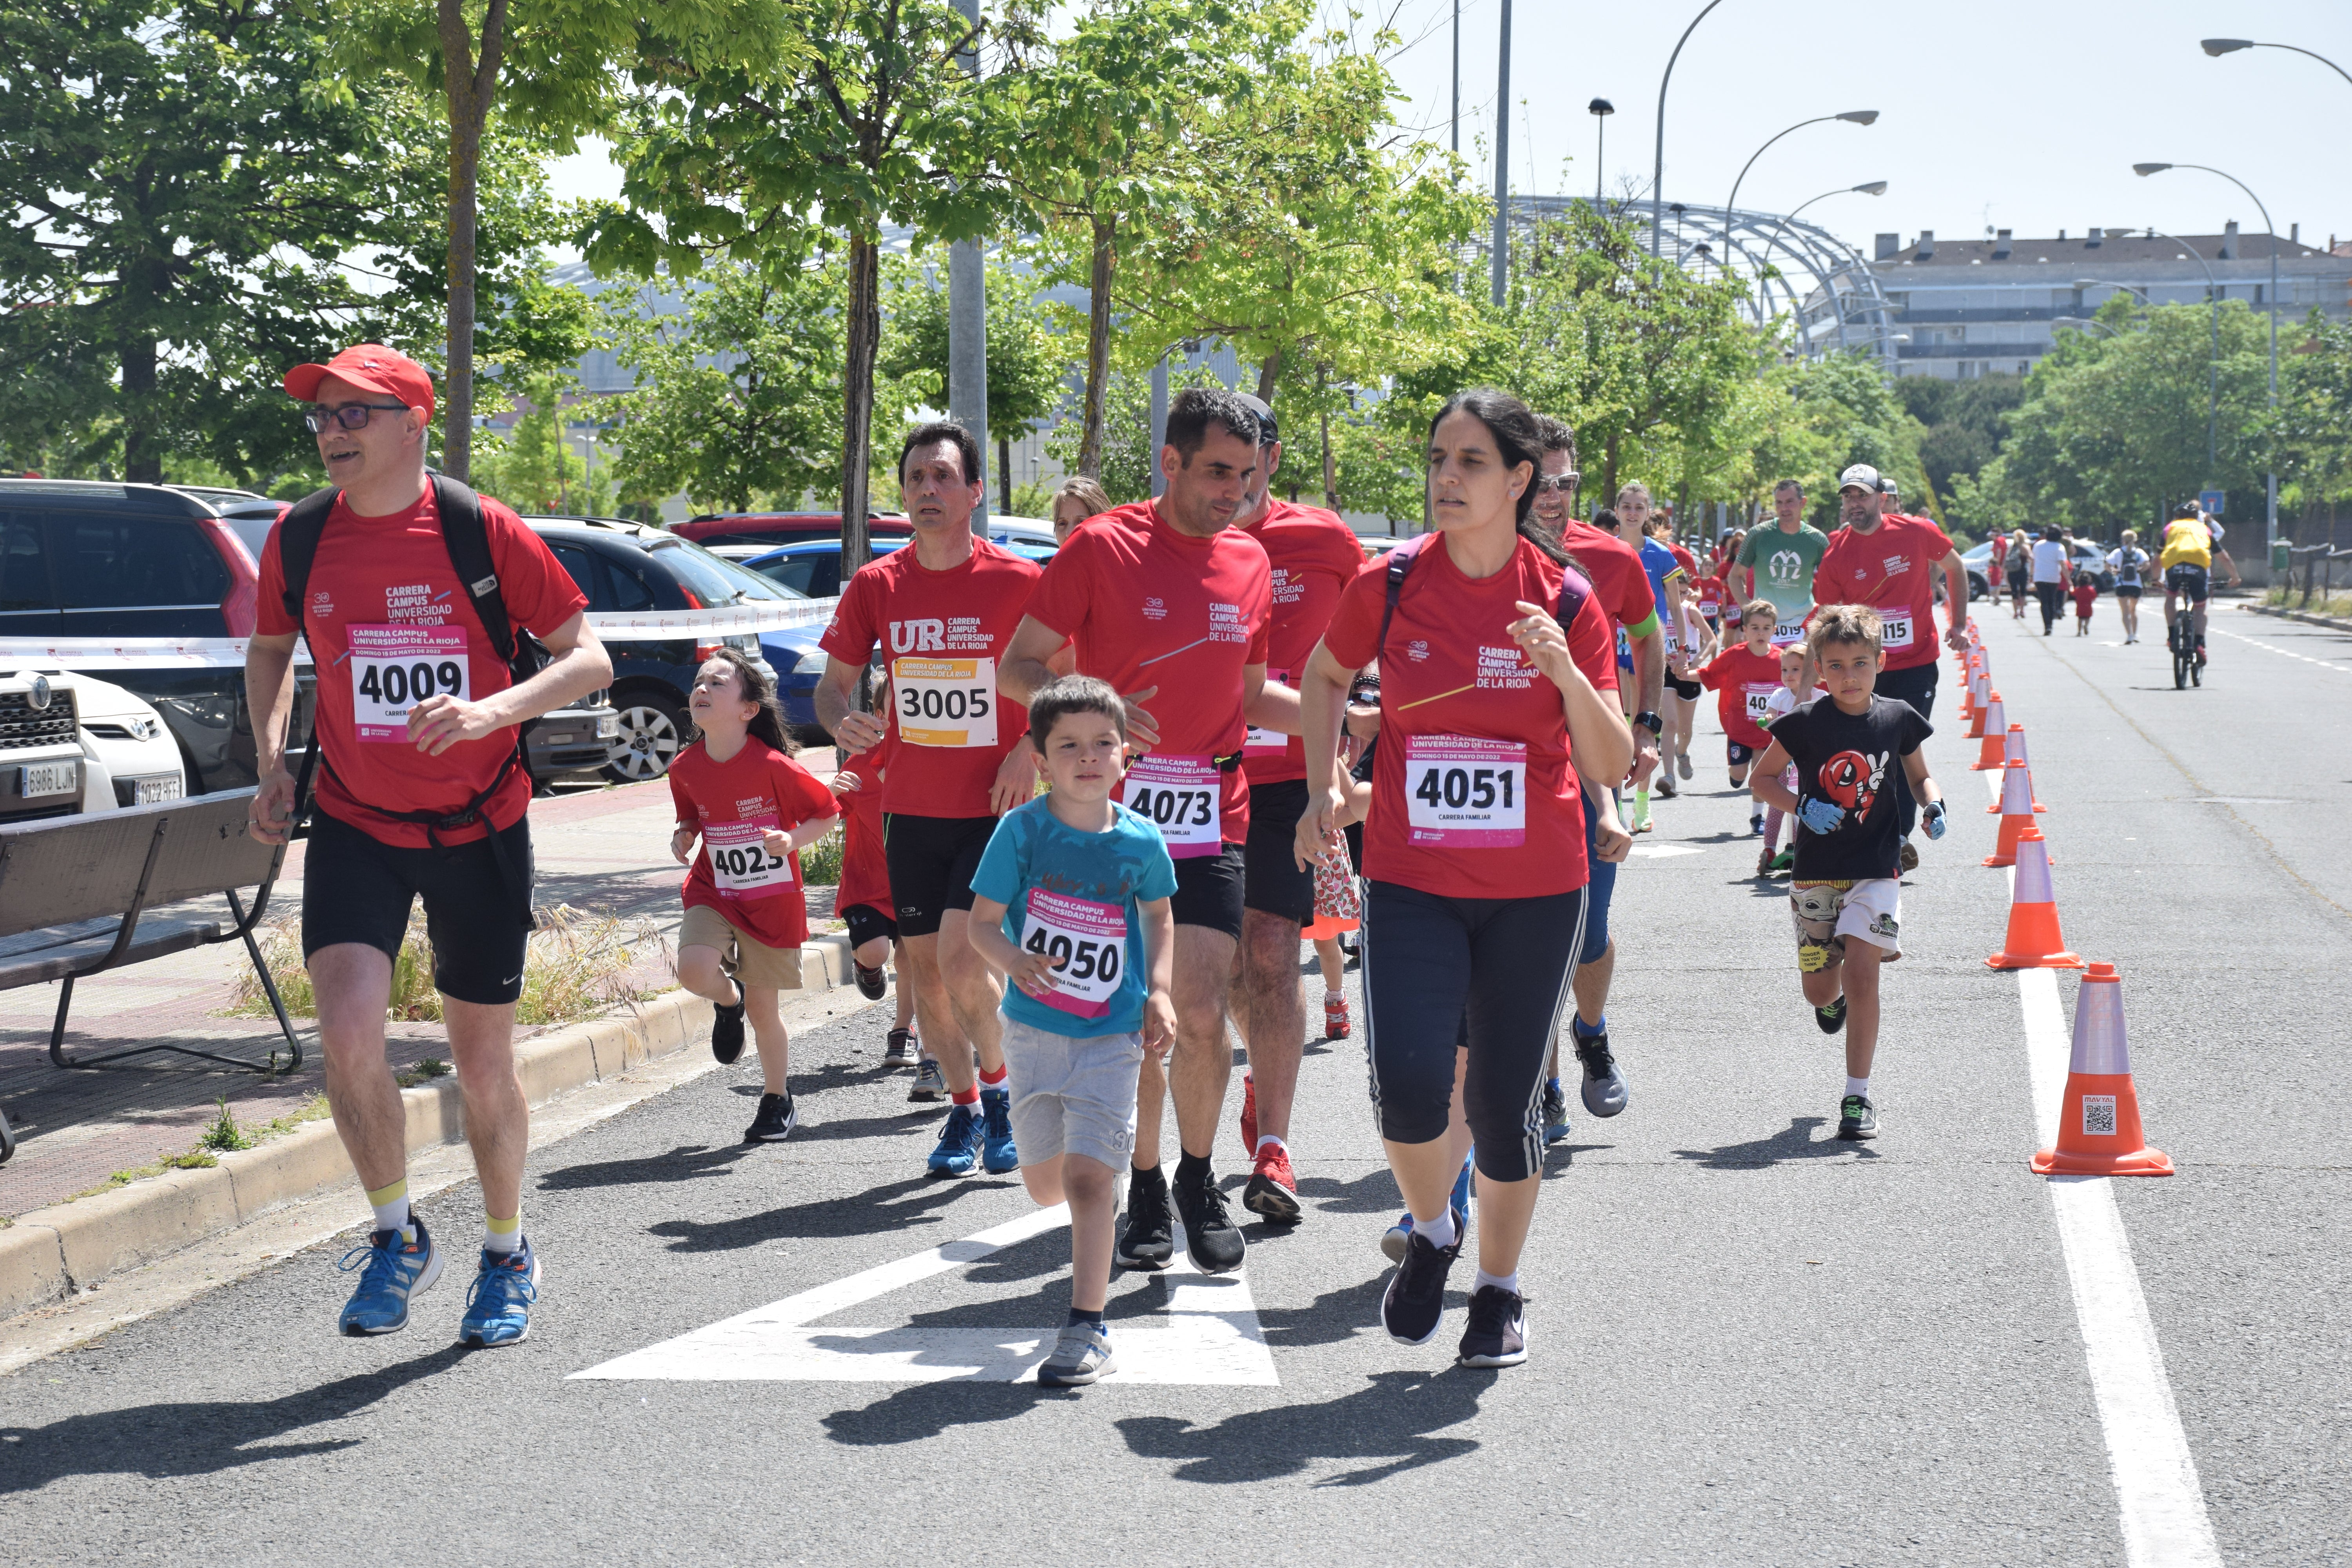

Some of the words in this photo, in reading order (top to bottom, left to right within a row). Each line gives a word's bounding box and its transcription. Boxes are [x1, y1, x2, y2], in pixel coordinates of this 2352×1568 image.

[1883, 555, 1901, 564] CARRERA
[1885, 560, 1901, 568] CAMPUS
[386, 584, 431, 597] CARRERA
[314, 592, 329, 603] 30
[387, 595, 428, 608] CAMPUS
[1146, 597, 1163, 608] 30
[1279, 593, 1299, 603] RIOJA
[387, 604, 452, 619] UNIVERSIDAD
[1209, 603, 1240, 613] CARRERA
[418, 616, 445, 626] RIOJA
[1210, 612, 1238, 623] CAMPUS
[1210, 622, 1249, 634] UNIVERSIDAD
[1774, 625, 1801, 636] 4019
[354, 637, 409, 645] UNIVERSIDAD
[889, 619, 946, 653] UR
[947, 633, 994, 642] UNIVERSIDAD
[1209, 632, 1219, 641] DE
[1221, 633, 1230, 641] LA
[1232, 633, 1246, 643] RIOJA
[1408, 641, 1427, 651] 30
[1479, 646, 1521, 660] CARRERA
[1478, 656, 1517, 670] CAMPUS
[1477, 667, 1539, 679] UNIVERSIDAD
[359, 661, 462, 705] 4009
[1477, 678, 1490, 688] DE
[1492, 678, 1504, 688] LA
[1506, 678, 1531, 689] RIOJA
[901, 688, 989, 719] 3005
[1749, 696, 1771, 710] 40
[1132, 762, 1182, 773] UNIVERSIDAD
[29, 768, 53, 793] 6986
[56, 766, 74, 790] LJN
[141, 782, 162, 805] 1022
[1416, 768, 1514, 809] 4051
[736, 796, 763, 807] CARRERA
[1129, 788, 1212, 826] 4073
[738, 803, 762, 813] CAMPUS
[739, 805, 777, 818] UNIVERSIDAD
[1034, 892, 1069, 909] CARRERA
[1071, 904, 1105, 915] CAMPUS
[1031, 909, 1055, 924] DOMINGO
[1033, 898, 1085, 920] UNIVERSIDAD
[1109, 918, 1124, 927] RIOJA
[1026, 927, 1119, 983] 4050
[1051, 975, 1066, 985] RERA
[1067, 980, 1091, 992] FAMILIAR
